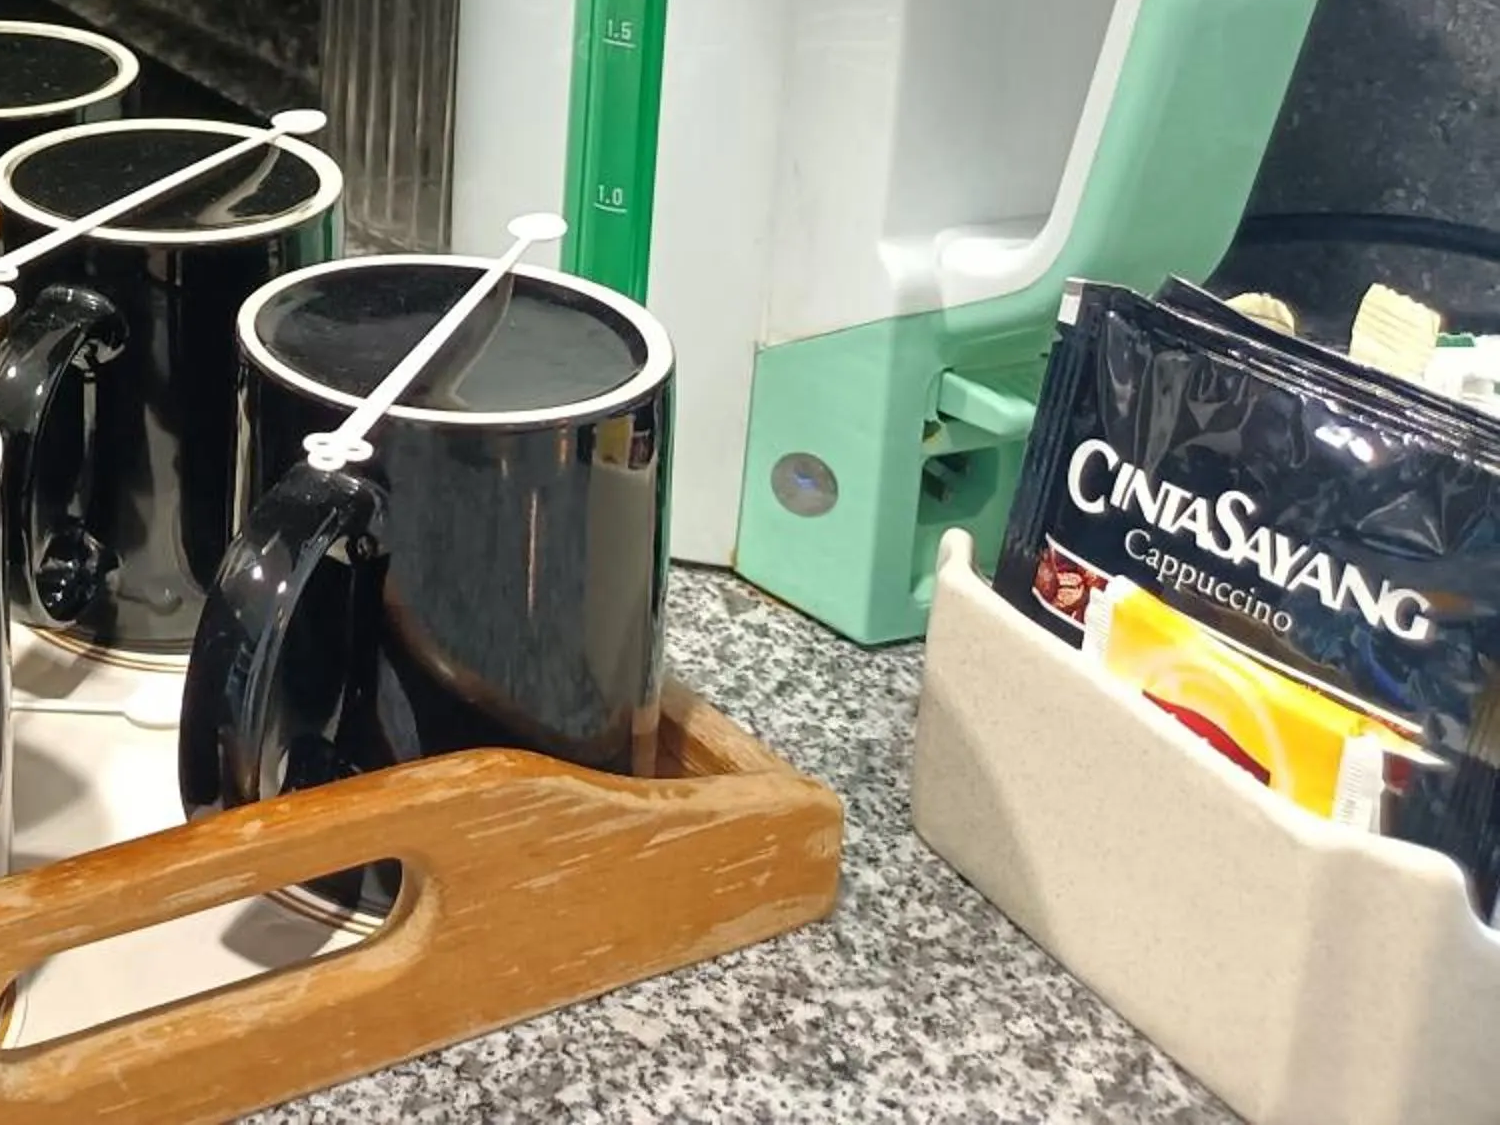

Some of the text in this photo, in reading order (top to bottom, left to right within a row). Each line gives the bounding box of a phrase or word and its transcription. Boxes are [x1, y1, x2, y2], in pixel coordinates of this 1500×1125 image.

[607, 18, 633, 41] 1.5
[598, 184, 624, 206] 1.0
[1124, 528, 1293, 635] Cappuccino
